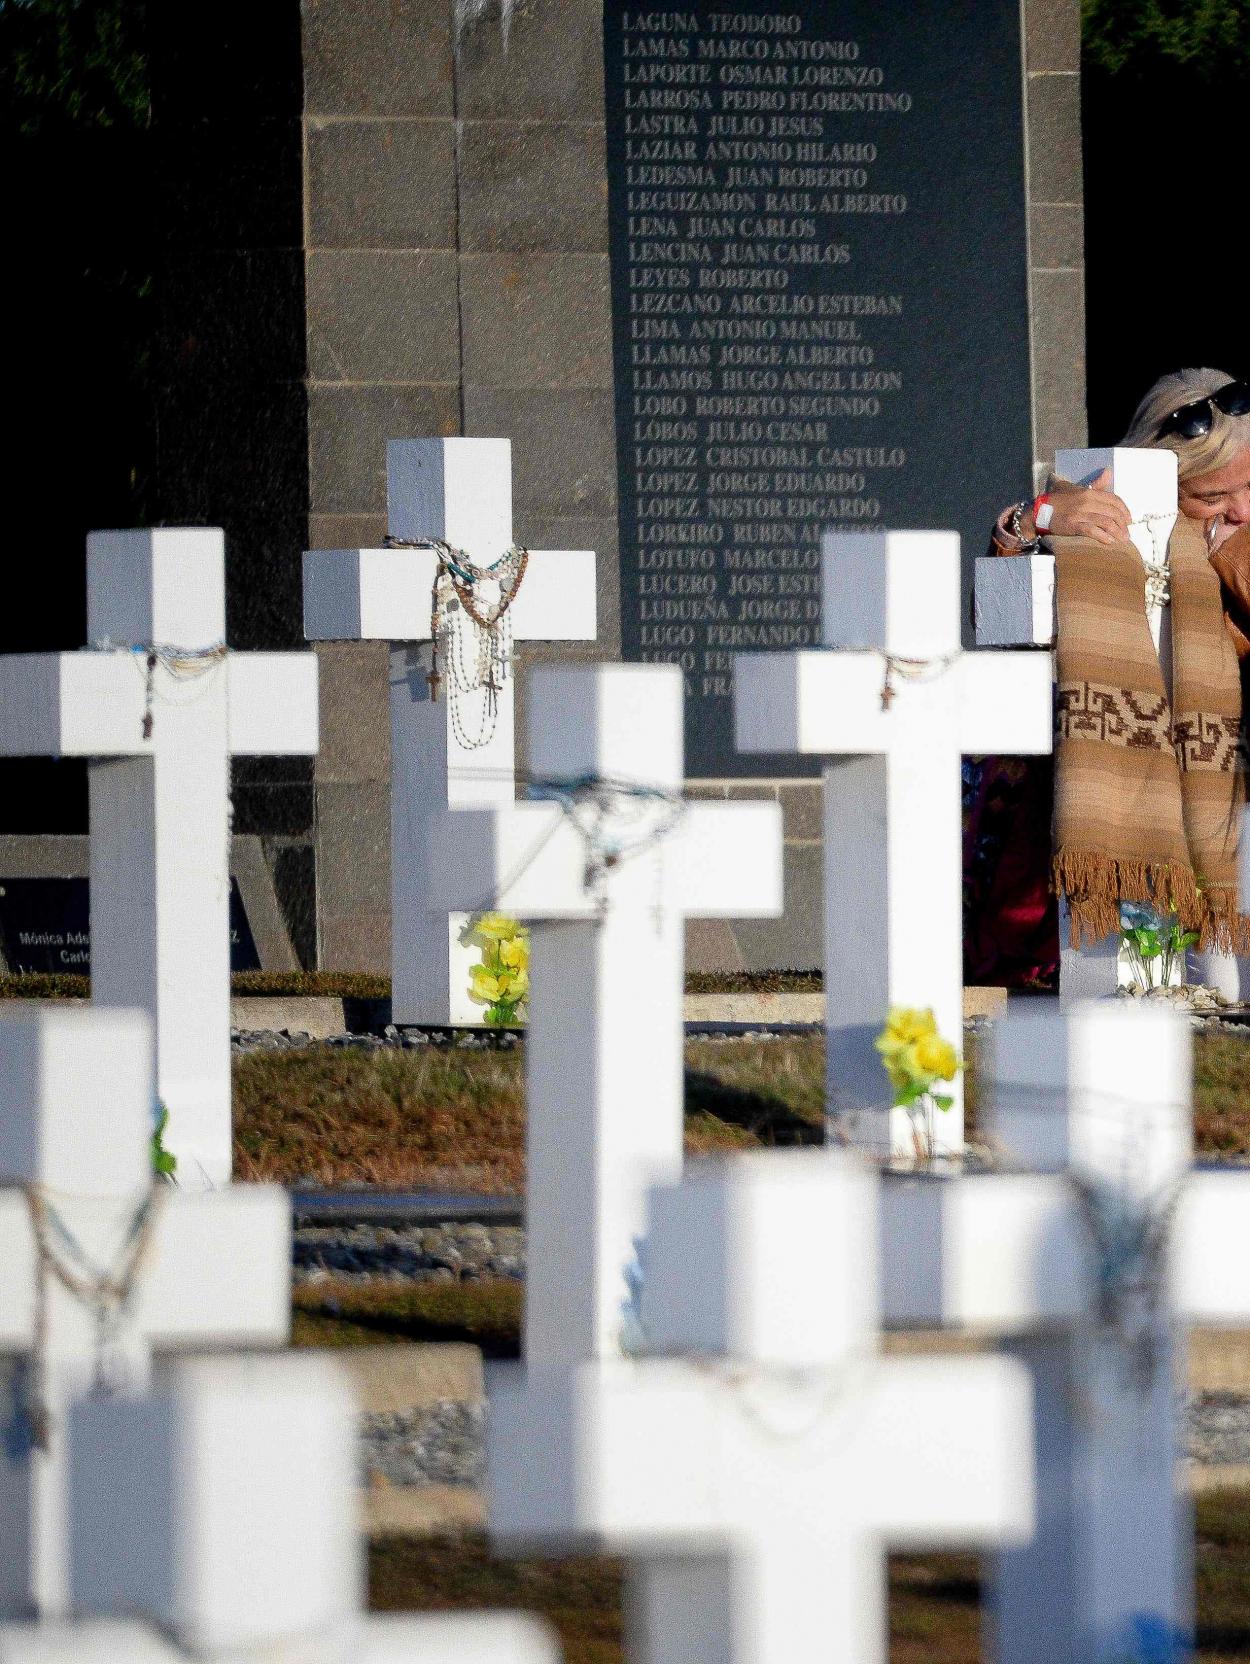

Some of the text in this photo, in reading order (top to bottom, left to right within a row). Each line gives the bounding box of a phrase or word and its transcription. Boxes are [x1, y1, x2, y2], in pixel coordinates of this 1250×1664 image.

[622, 12, 802, 34] LAGUNA TEODORO
[623, 38, 859, 60] LAMAS MARCO ANTONIO
[623, 64, 884, 86] LAPORTE OSMAR LORENZO
[624, 90, 912, 112] LARROSA PEDRO FLORENTINO
[625, 115, 823, 138] LASTRA JULIO JESUS
[705, 142, 792, 162] ANTONIO
[796, 143, 878, 162] HILARIO
[626, 167, 867, 189] LEDESMA JUAN ROBERTO
[627, 192, 908, 213] LEGUIZAMON RAUL ALBERTO
[628, 217, 816, 239] LENA JUAN CARLOS
[629, 243, 850, 265] LENCINA JUAN CARLOS
[630, 269, 789, 289] LEYES ROBERTO
[630, 294, 721, 313] LEZCANO
[818, 295, 903, 314] ESTEBAN
[631, 320, 862, 340] LIMA ANTONIO MANUEL
[632, 346, 874, 367] LLAMAS JORGE ALBERTO
[632, 371, 903, 391] LLAMOS HUGO ANGEL LEON
[633, 396, 880, 416] LOBO ROBERTO SEGUNDO
[706, 422, 762, 443] JULIO
[767, 422, 829, 441] CESAR
[635, 448, 905, 467] LOPEZ CRISTOBAL CASTULO
[636, 473, 865, 494] LOPEZ JORGE EDUARDO
[637, 499, 880, 517] LOPEZ NESTOR EDGARDO
[733, 525, 795, 543] RUBEN
[723, 549, 818, 568] MARCELO
[640, 575, 717, 593] LUCERO
[729, 575, 773, 596] JOSE
[739, 601, 801, 622] JORGE
[641, 626, 695, 644] LUGO
[707, 626, 809, 644] FERNANDO
